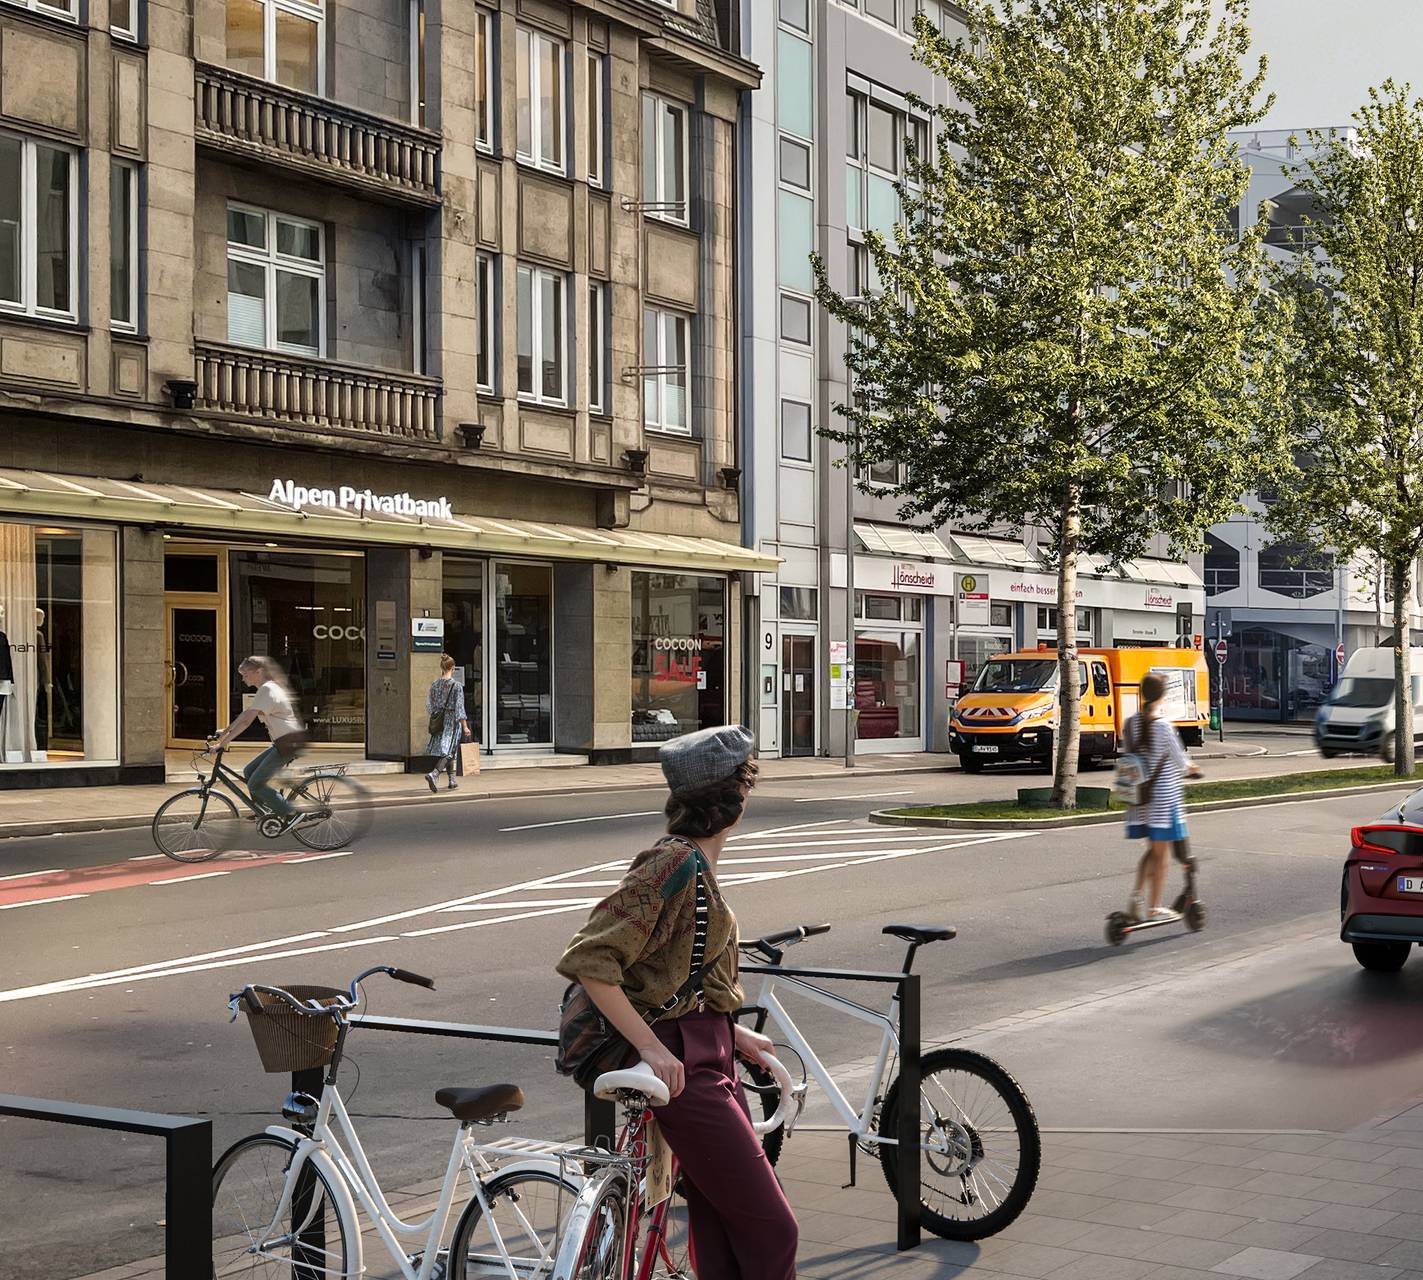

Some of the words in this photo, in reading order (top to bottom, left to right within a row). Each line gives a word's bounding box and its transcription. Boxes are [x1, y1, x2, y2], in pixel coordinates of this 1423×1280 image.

[269, 478, 336, 511] Alpen
[339, 485, 453, 520] Privatbank
[1010, 582, 1035, 594] einfach
[1036, 584, 1056, 596] besser
[655, 637, 702, 651] COCOON
[765, 633, 773, 650] 9
[655, 652, 703, 683] SALE
[1406, 879, 1413, 890] D
